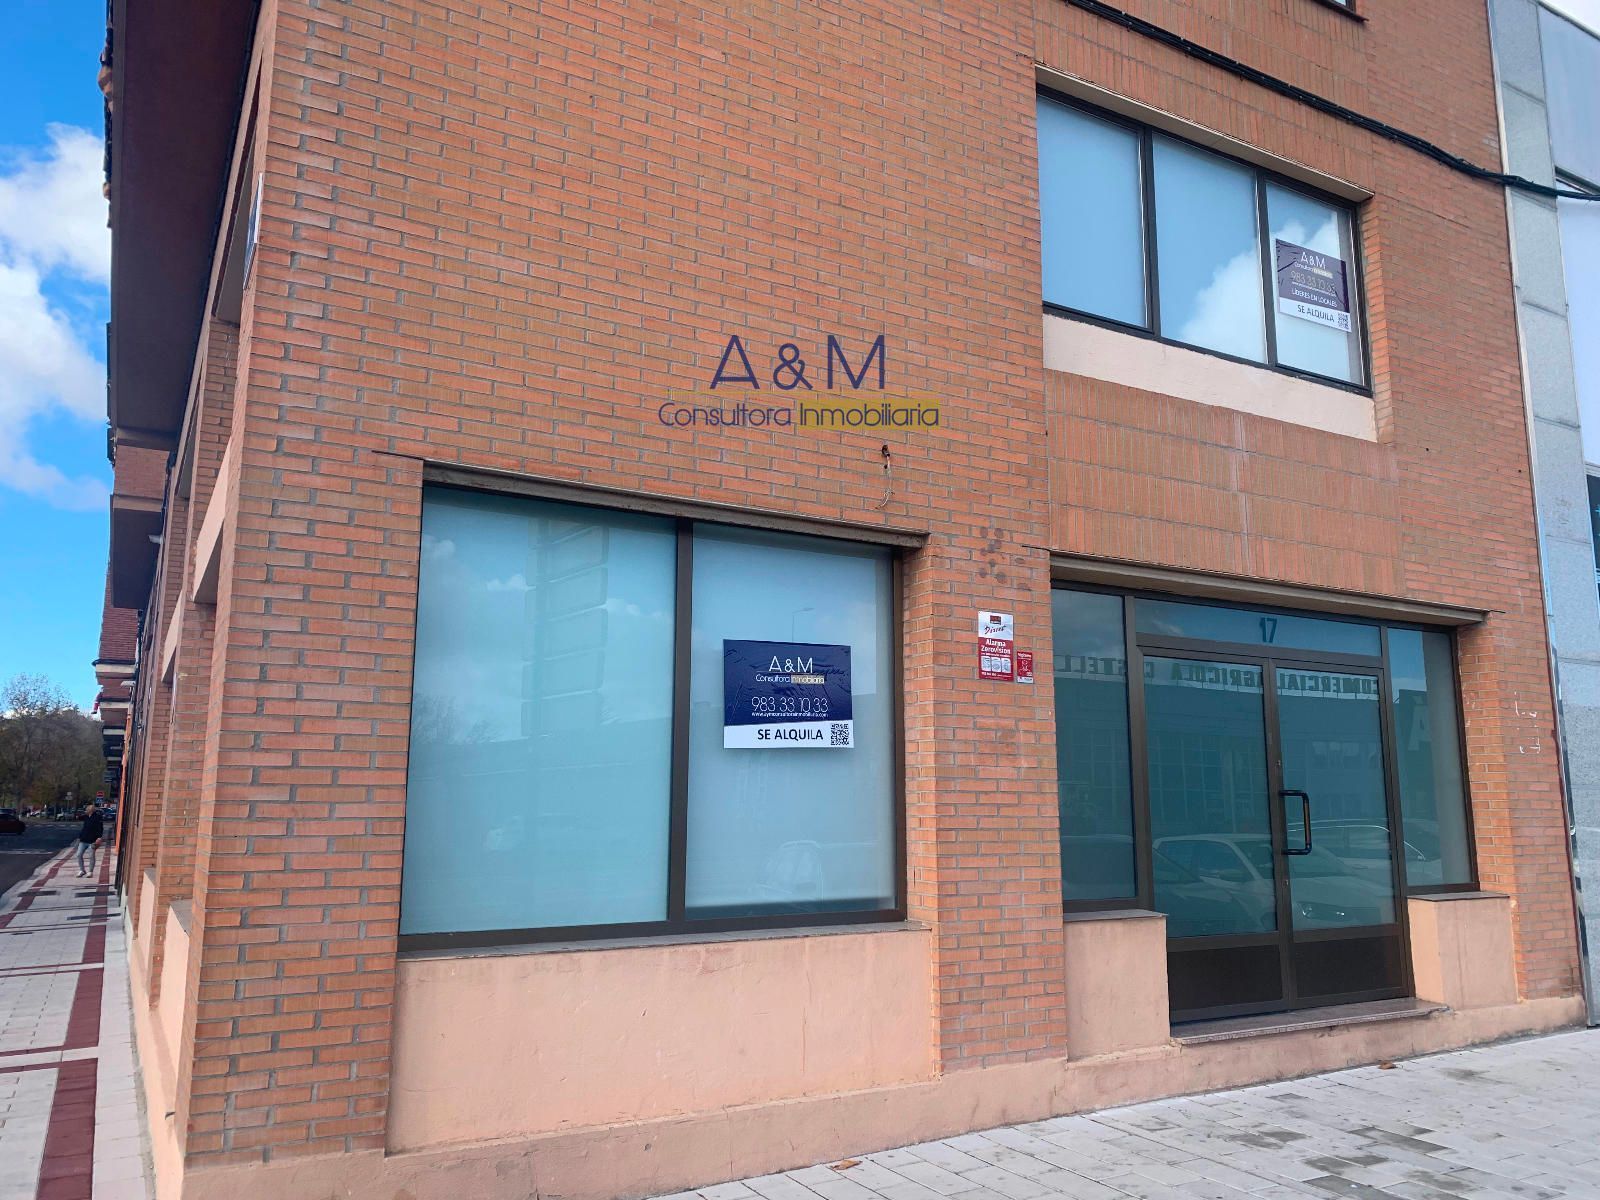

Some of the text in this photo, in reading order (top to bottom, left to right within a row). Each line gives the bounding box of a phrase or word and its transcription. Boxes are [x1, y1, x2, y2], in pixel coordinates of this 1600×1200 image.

[1297, 304, 1335, 322] SE ALQUILA
[1259, 617, 1278, 643] 17
[755, 673, 791, 683] Consultora
[751, 696, 829, 713] 983 33 10 33
[757, 729, 824, 741] SE ALQUILA
